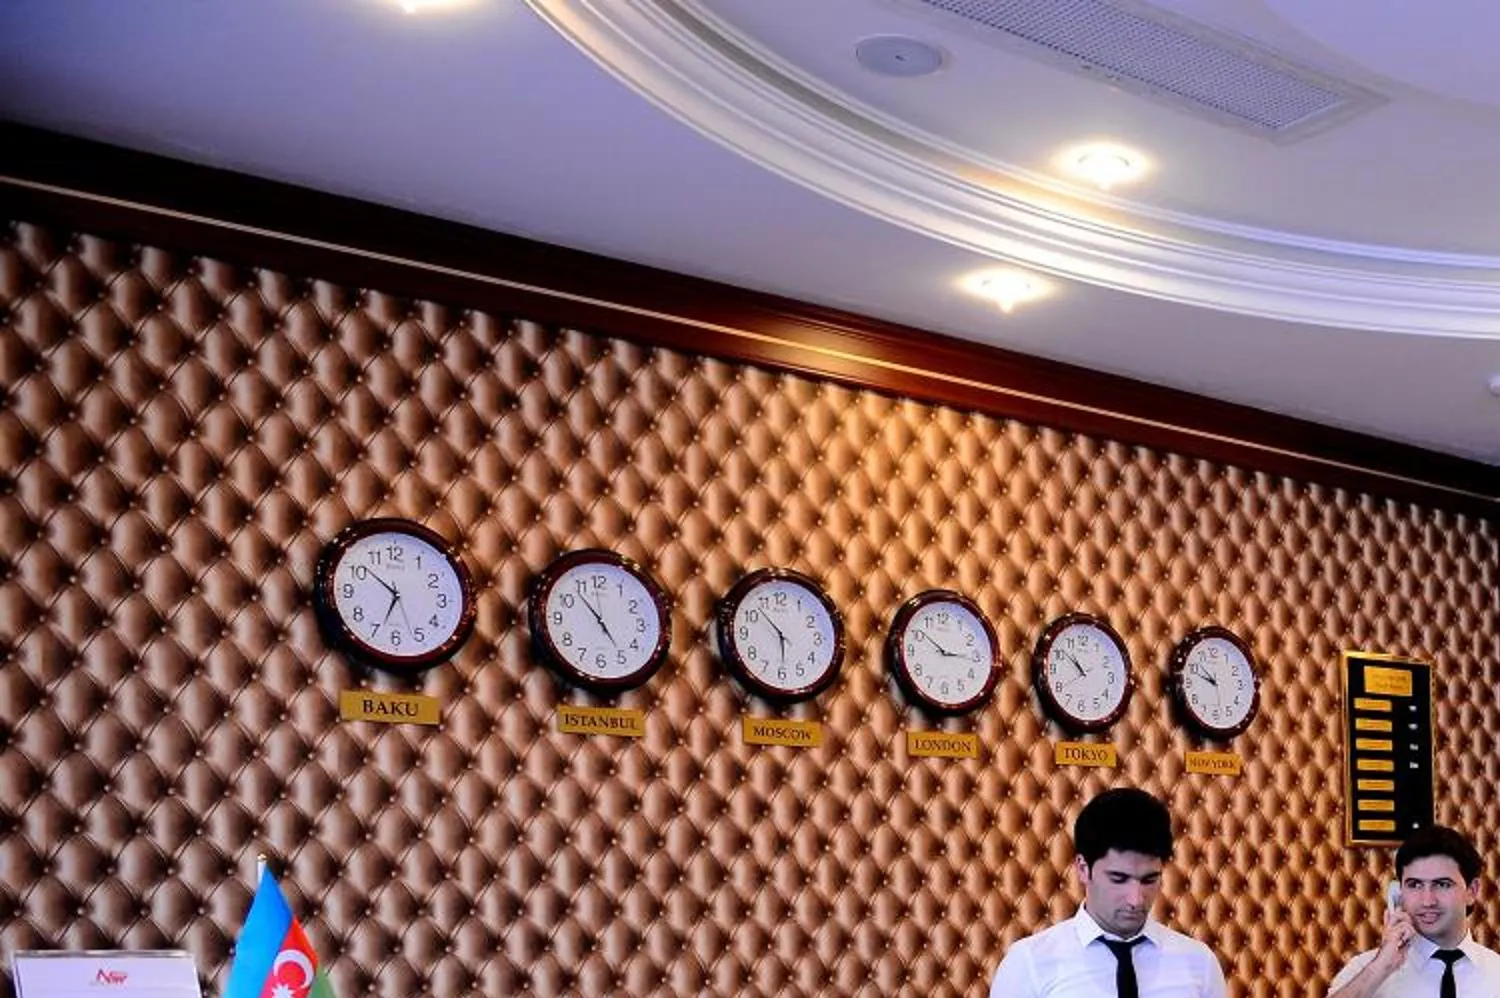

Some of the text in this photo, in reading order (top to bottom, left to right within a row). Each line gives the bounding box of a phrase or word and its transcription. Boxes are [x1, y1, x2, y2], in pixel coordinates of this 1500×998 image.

[368, 551, 381, 564] 11
[386, 546, 403, 562] 12
[416, 555, 421, 570] 1
[350, 565, 367, 580] 10
[428, 573, 438, 588] 2
[576, 580, 586, 593] 11
[592, 576, 606, 589] 12
[343, 584, 354, 598] 9
[617, 583, 622, 597] 1
[436, 594, 447, 608] 3
[560, 594, 574, 608] 10
[759, 597, 769, 609] 11
[773, 592, 787, 606] 12
[629, 600, 638, 614] 2
[796, 600, 801, 612] 1
[353, 606, 364, 622] 8
[429, 614, 439, 627] 4
[553, 611, 562, 625] 9
[745, 610, 758, 623] 10
[636, 618, 646, 632] 3
[806, 615, 815, 628] 2
[924, 616, 933, 628] 11
[371, 623, 381, 638] 7
[414, 628, 424, 642] 5
[740, 626, 748, 640] 9
[911, 629, 925, 642] 10
[391, 630, 400, 646] 6
[562, 632, 572, 646] 8
[629, 638, 638, 650] 4
[813, 632, 822, 646] 3
[966, 633, 975, 646] 2
[1066, 638, 1075, 649] 11
[578, 648, 587, 661] 7
[748, 646, 757, 660] 8
[908, 644, 915, 656] 9
[595, 654, 606, 668] 6
[617, 650, 626, 664] 5
[808, 652, 815, 665] 4
[1103, 656, 1111, 668] 2
[761, 660, 769, 672] 7
[796, 663, 804, 676] 5
[914, 663, 922, 676] 8
[1050, 663, 1057, 675] 9
[778, 667, 786, 680] 6
[967, 668, 974, 679] 4
[1107, 671, 1115, 684] 3
[924, 675, 933, 688] 7
[941, 681, 949, 694] 6
[957, 680, 965, 691] 5
[1055, 681, 1063, 693] 8
[1065, 693, 1073, 706] 7
[1102, 688, 1109, 700] 4
[362, 699, 419, 717] BAKU
[1077, 700, 1086, 712] 6
[1093, 697, 1101, 710] 5
[564, 713, 637, 729] ISTANBUL
[752, 726, 812, 740] MOSCOW
[914, 738, 973, 753] LONDON
[1063, 747, 1109, 761] TOKYO
